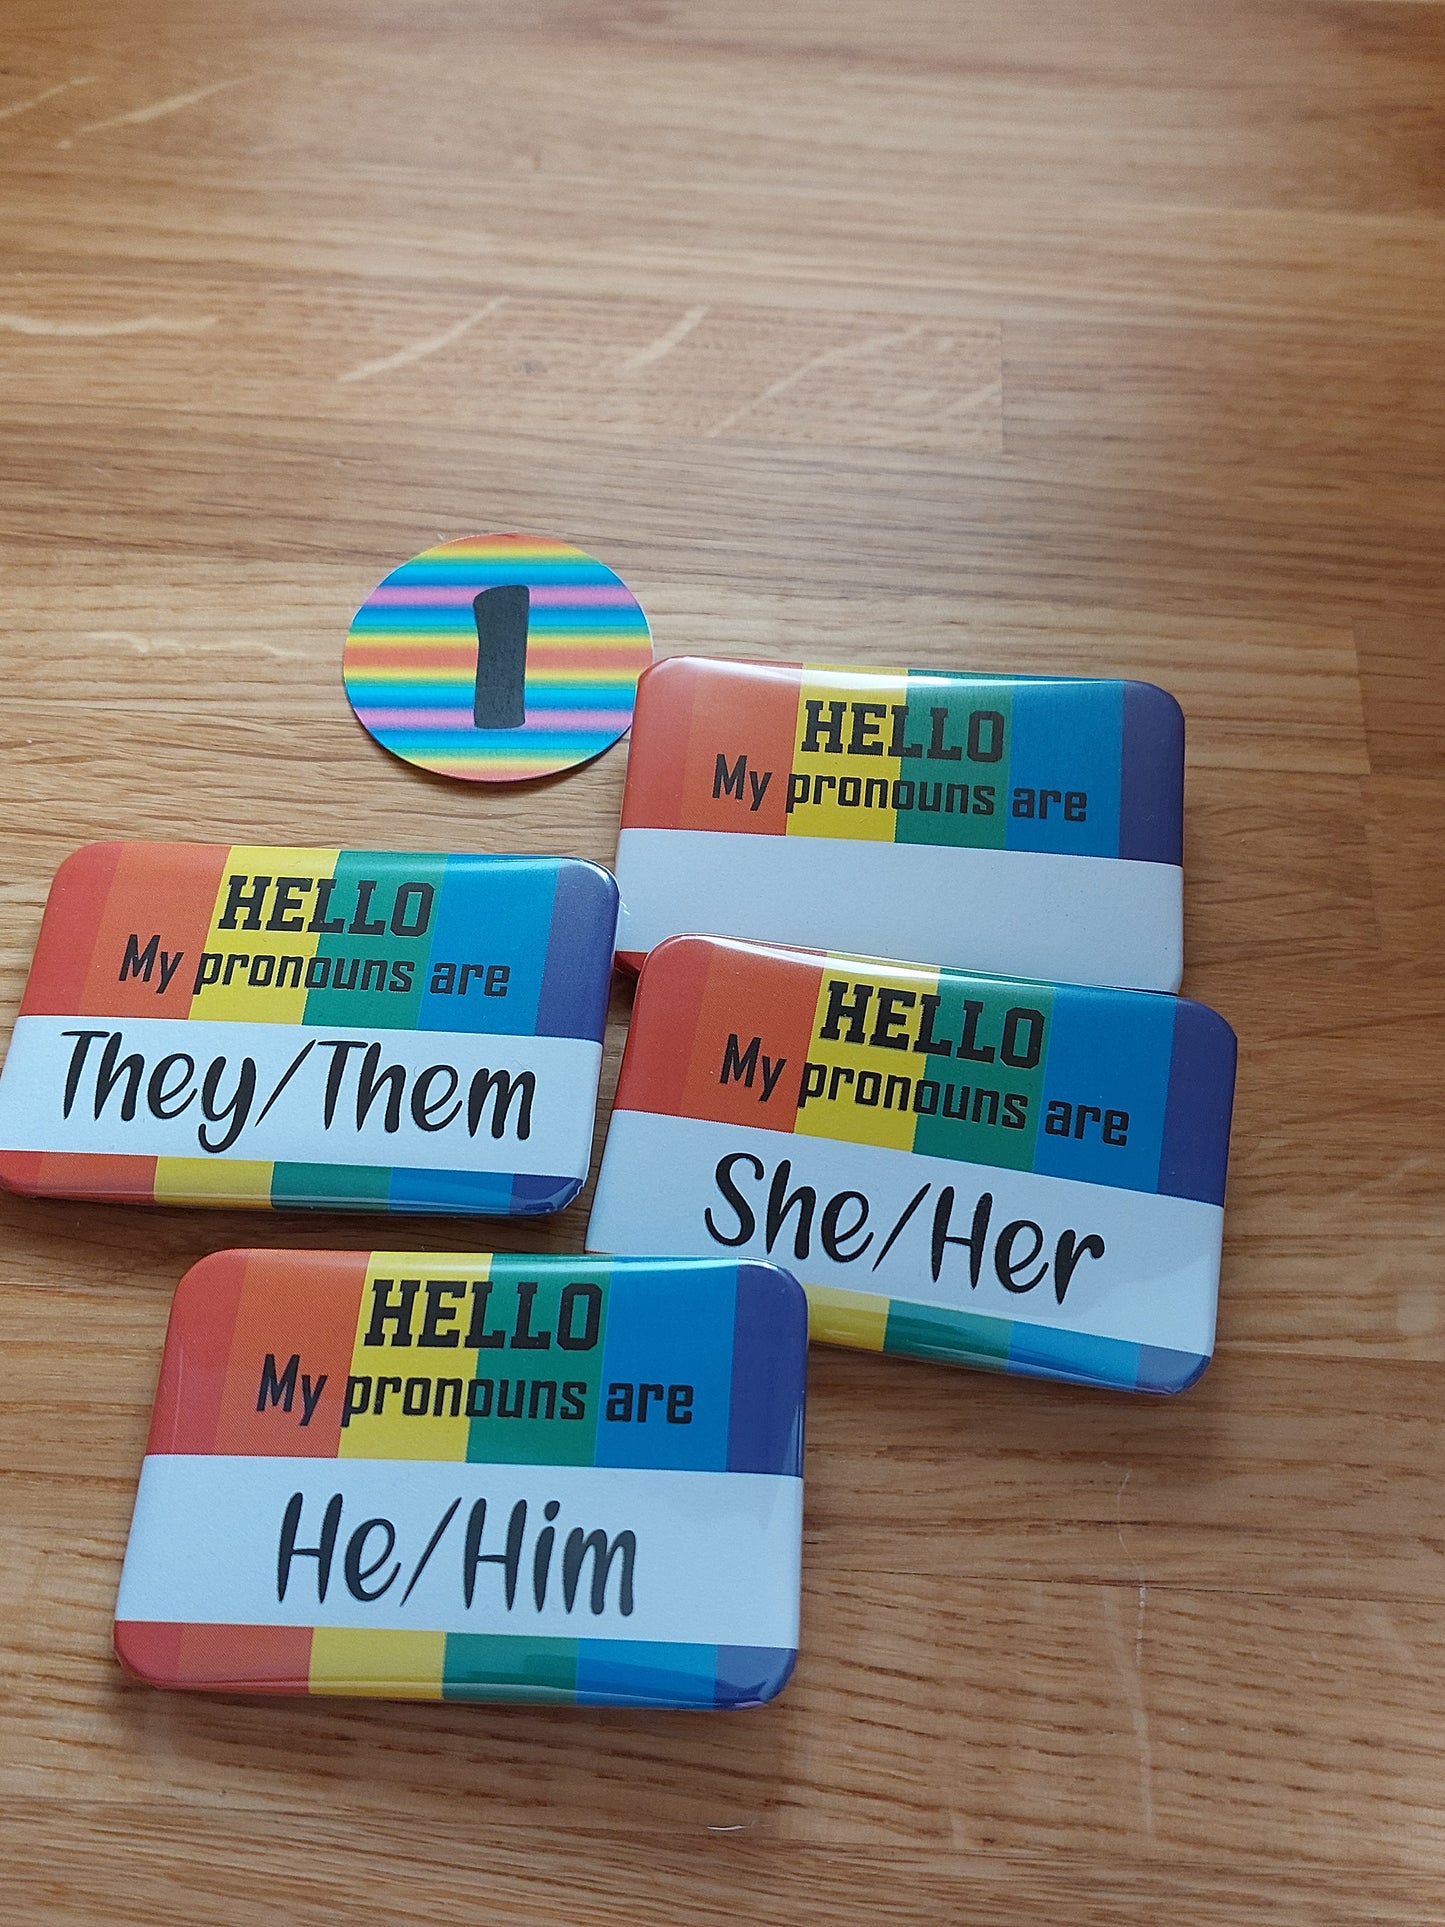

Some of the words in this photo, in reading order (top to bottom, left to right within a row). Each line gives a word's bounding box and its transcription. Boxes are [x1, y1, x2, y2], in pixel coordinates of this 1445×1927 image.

[473, 584, 530, 729] 1
[800, 700, 1006, 764] HELLO
[711, 754, 773, 812] My
[785, 766, 996, 816] pronouns
[1011, 785, 1087, 823] are
[218, 875, 436, 937] HELLO
[118, 934, 183, 994] My
[192, 951, 413, 995] pronouns
[430, 959, 511, 997] are
[819, 980, 1045, 1069] HELLO
[61, 1030, 536, 1153] They/Them
[719, 1033, 787, 1102] My
[798, 1060, 1028, 1129] pronouns
[1045, 1100, 1129, 1146] are
[704, 1152, 1105, 1305] She/Her
[364, 1278, 603, 1351] HELLO
[255, 1353, 328, 1426] My
[340, 1373, 587, 1427] pronouns
[607, 1382, 694, 1425] are
[277, 1492, 636, 1617] He/Him
